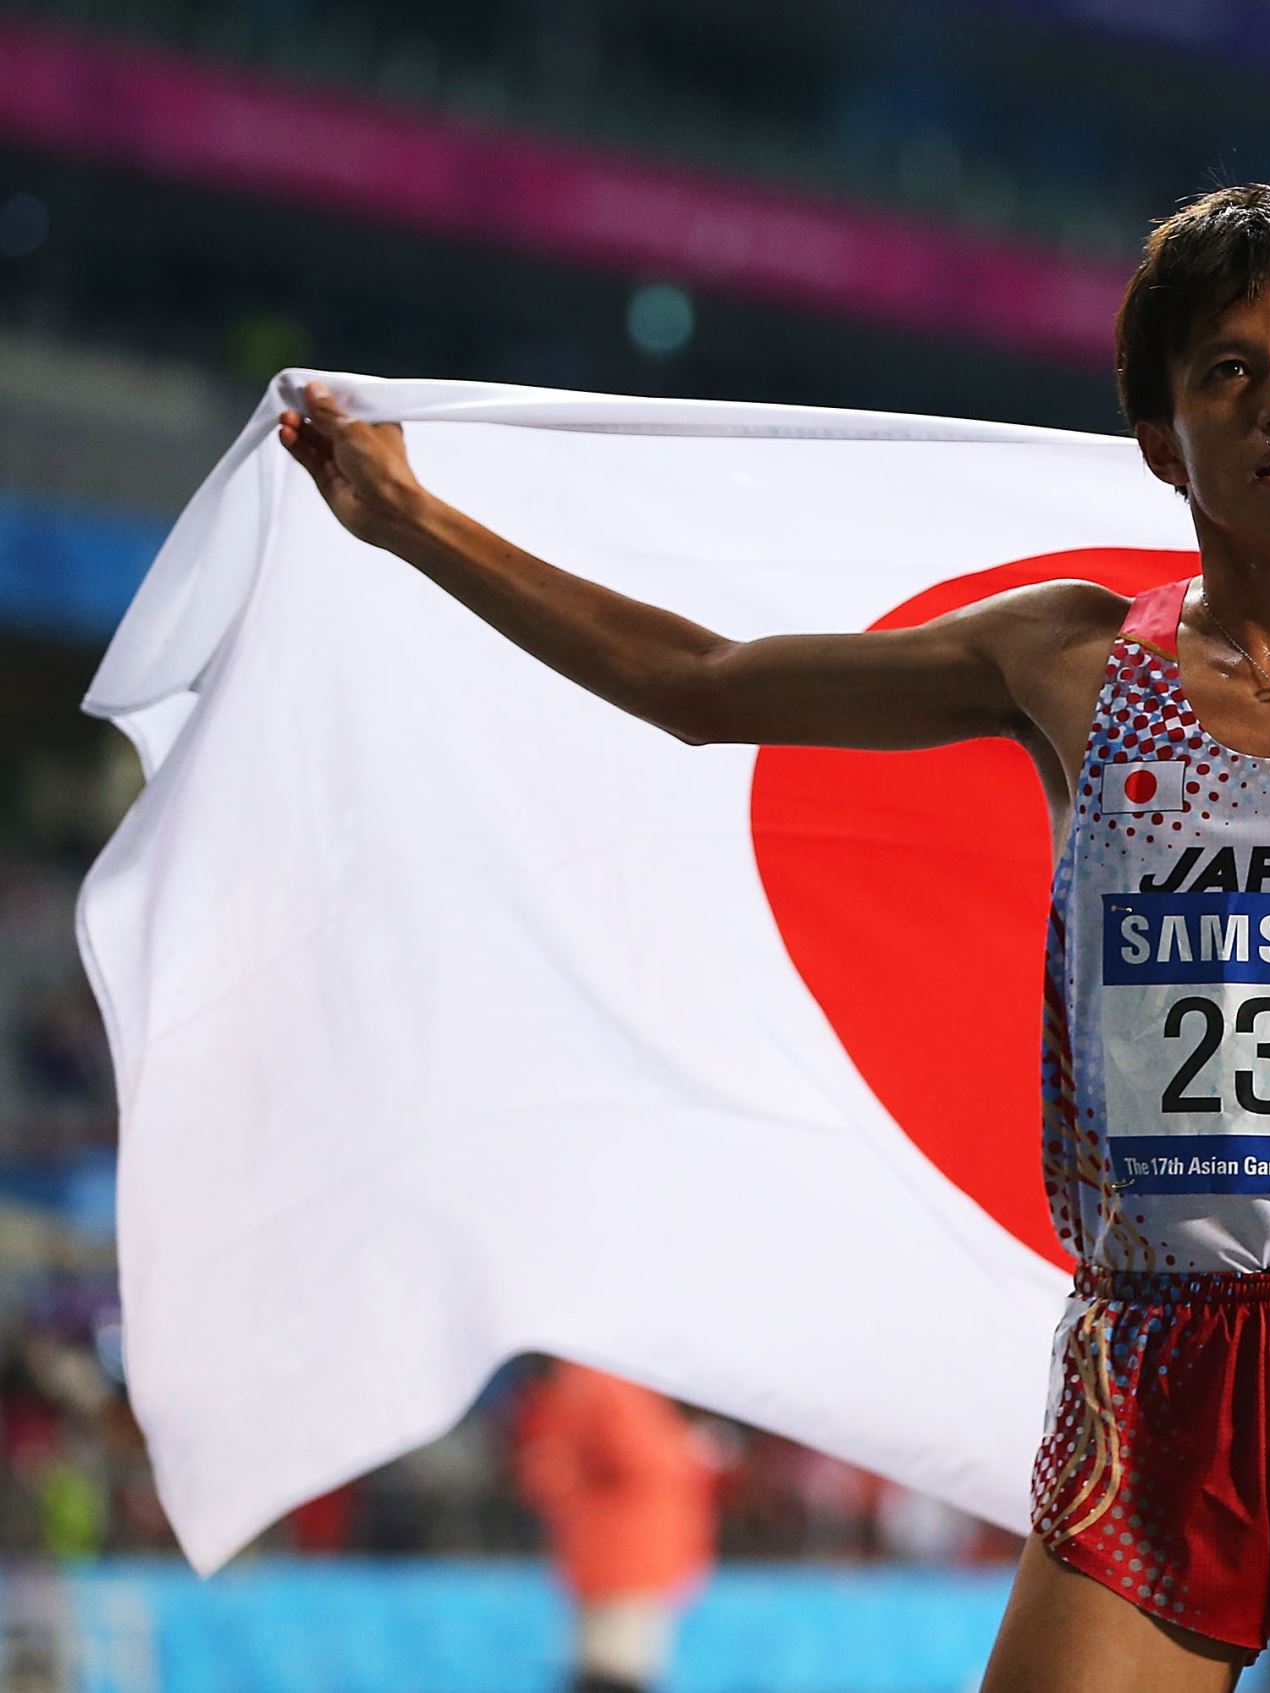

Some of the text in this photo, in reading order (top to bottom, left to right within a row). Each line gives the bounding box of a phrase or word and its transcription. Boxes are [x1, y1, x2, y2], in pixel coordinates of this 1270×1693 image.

[1125, 1157, 1149, 1176] The
[1151, 1158, 1183, 1176] 17th
[1188, 1158, 1239, 1176] Asian
